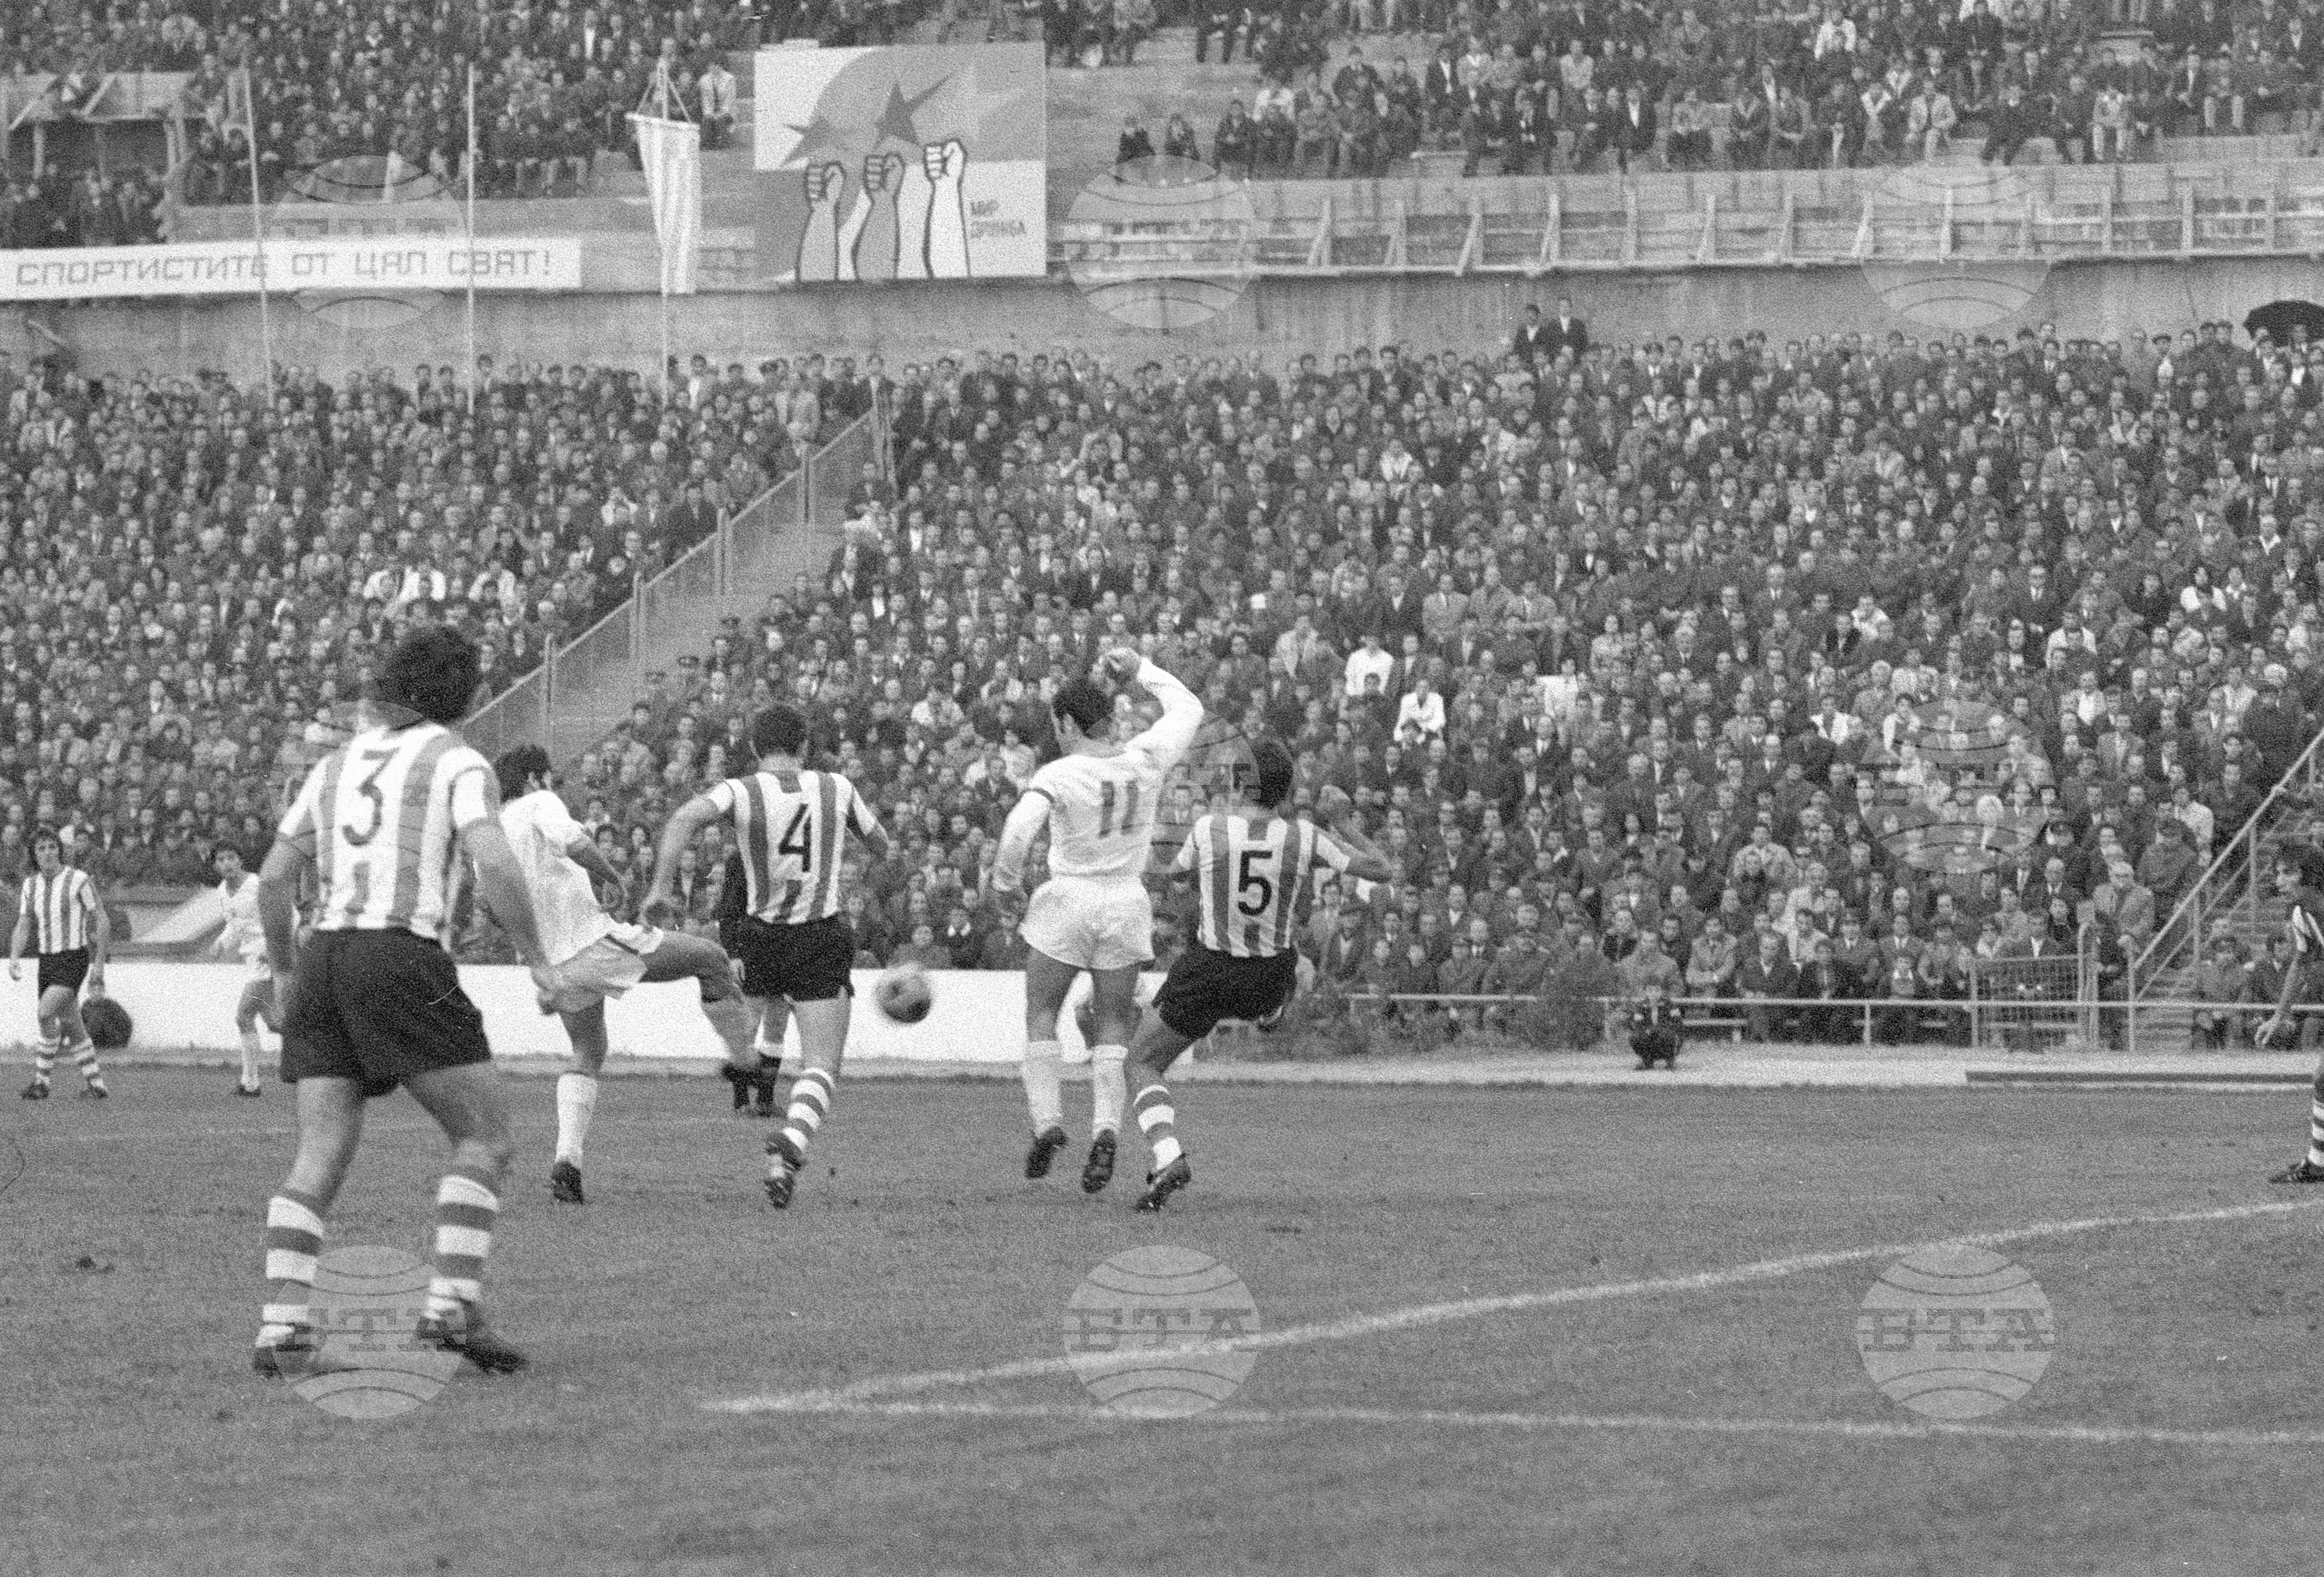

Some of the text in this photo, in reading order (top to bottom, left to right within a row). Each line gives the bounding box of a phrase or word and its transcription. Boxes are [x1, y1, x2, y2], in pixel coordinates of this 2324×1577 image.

[16, 255, 268, 285] СПОРТИСТИТЕ
[292, 252, 335, 275] ОТ
[342, 747, 400, 846] 3
[1099, 779, 1139, 839] 11
[779, 804, 812, 872] 4
[1238, 850, 1272, 915] 5
